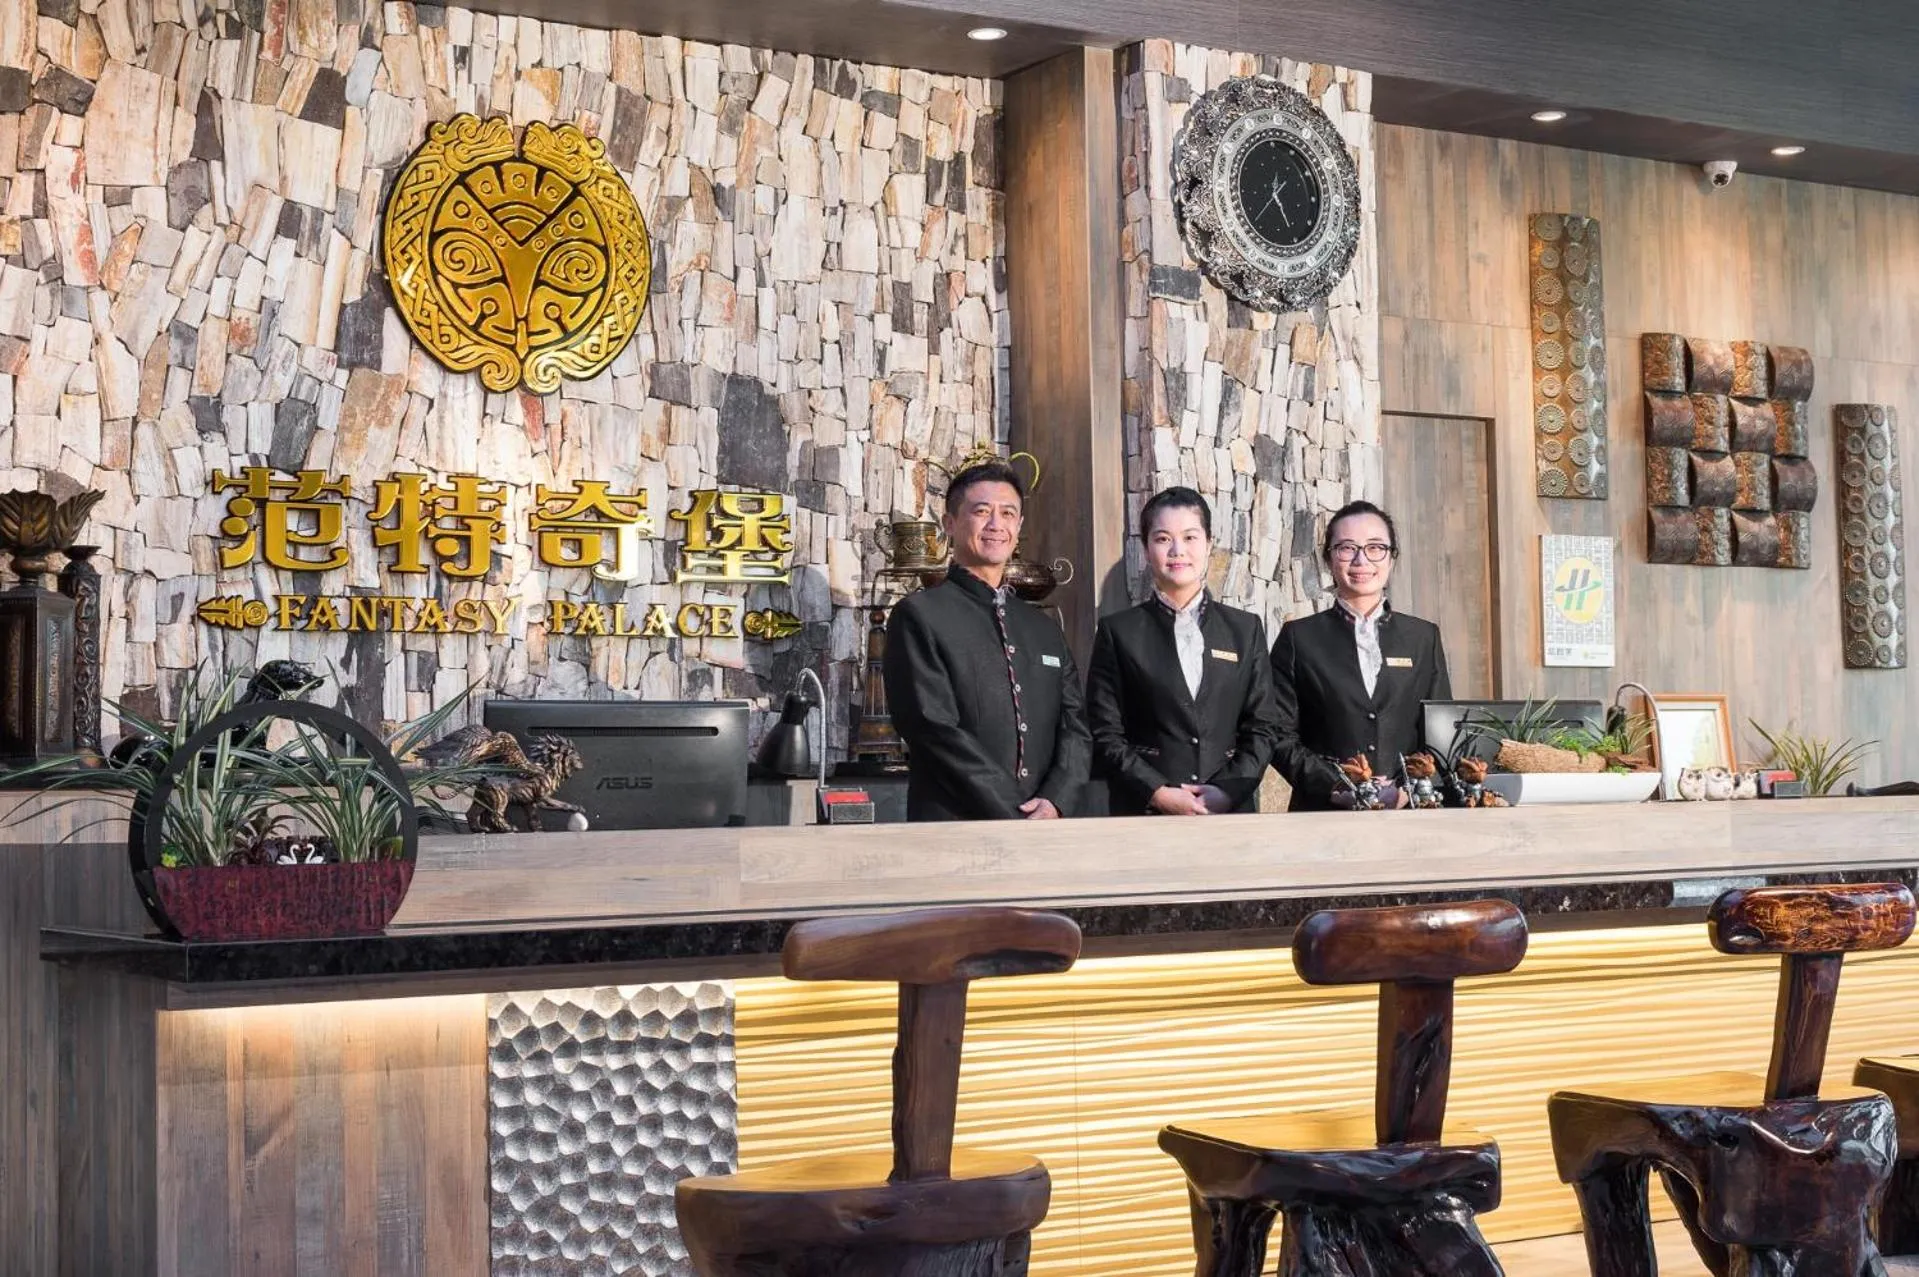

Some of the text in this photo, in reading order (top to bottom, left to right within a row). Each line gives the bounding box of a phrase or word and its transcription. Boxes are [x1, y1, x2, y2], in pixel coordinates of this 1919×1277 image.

[213, 466, 794, 584] 范特奇堡
[274, 594, 738, 639] FANTASY PALACE
[596, 776, 653, 790] ASUS
